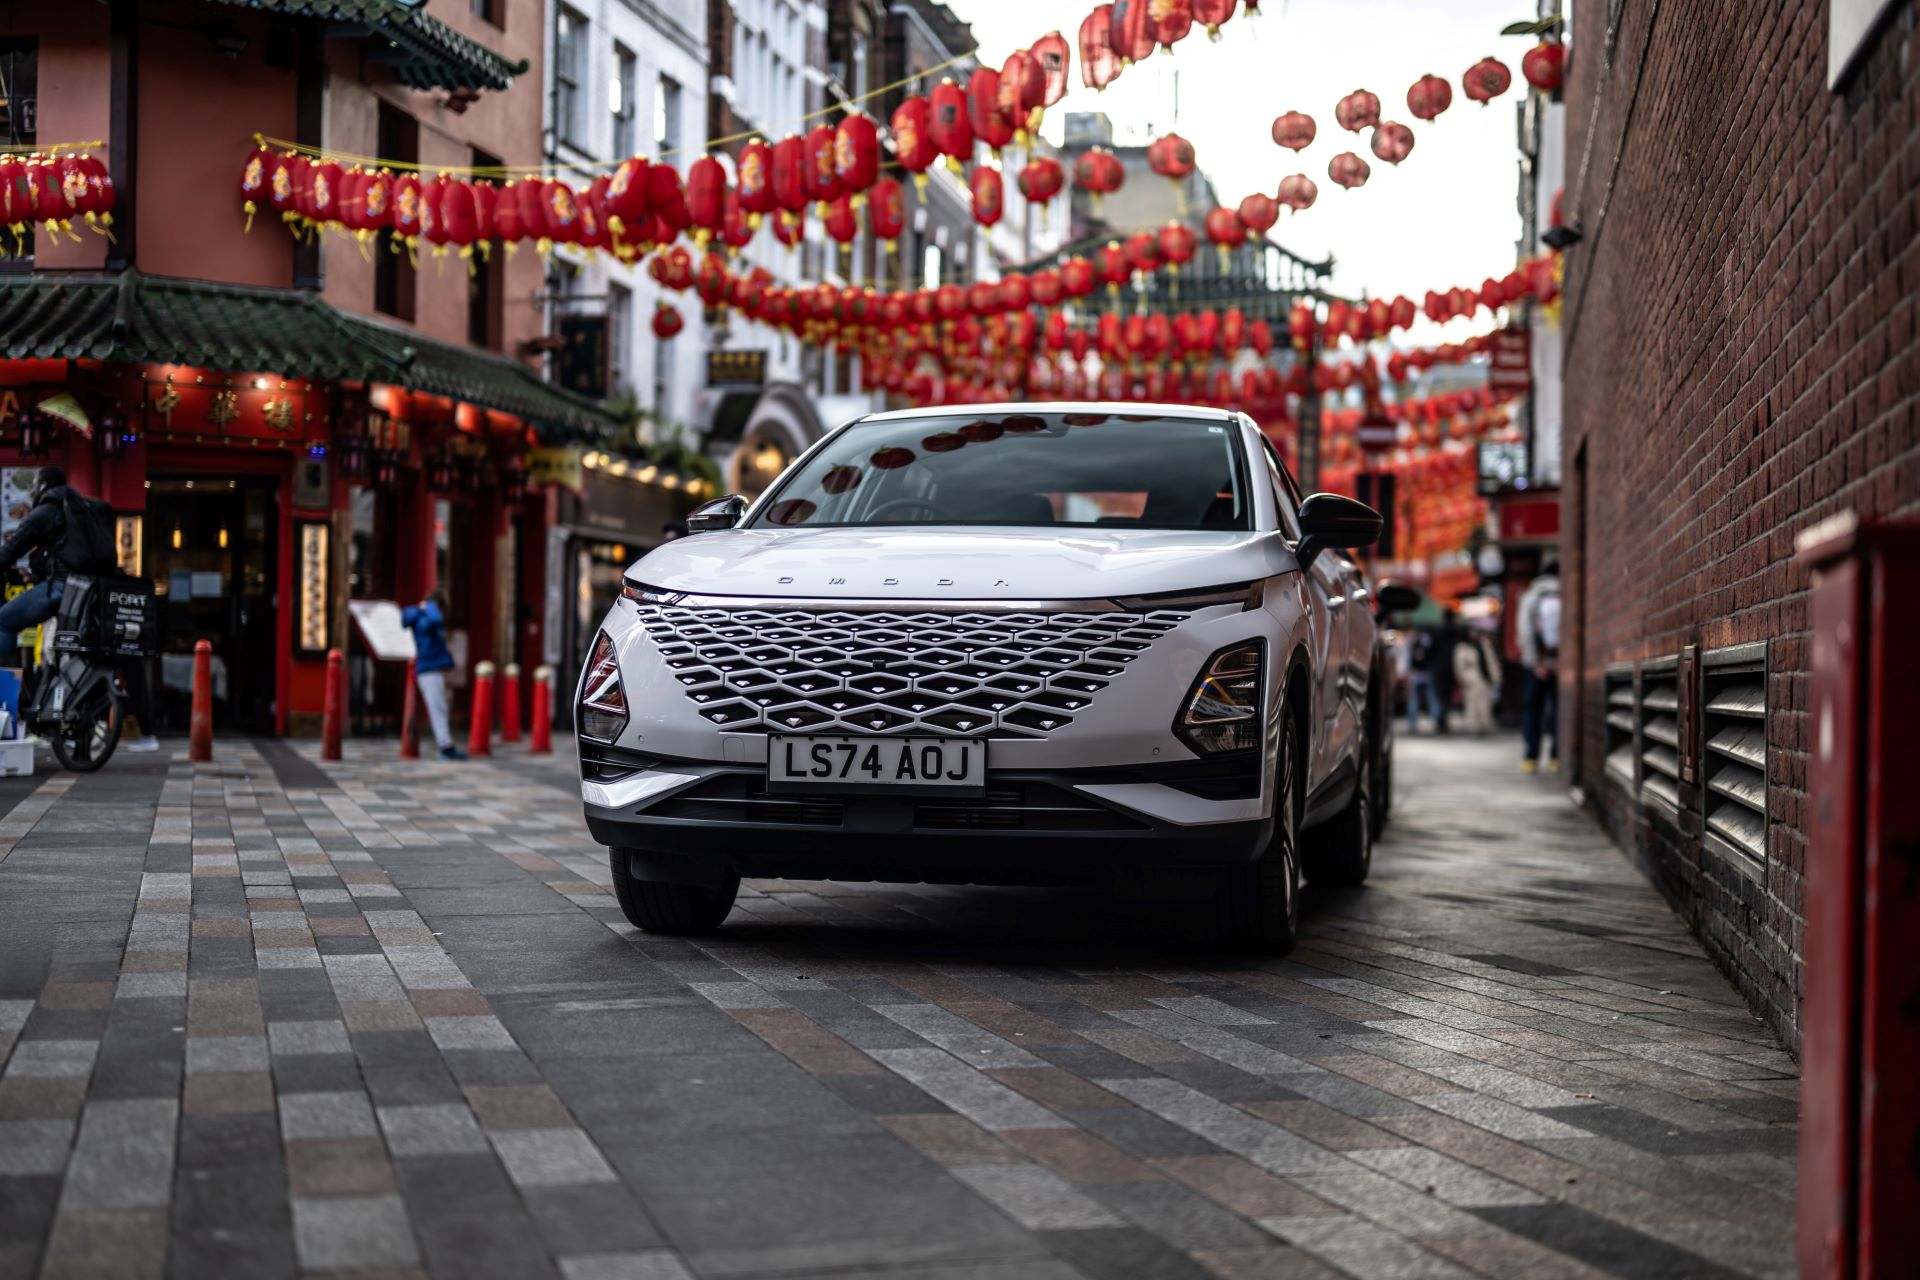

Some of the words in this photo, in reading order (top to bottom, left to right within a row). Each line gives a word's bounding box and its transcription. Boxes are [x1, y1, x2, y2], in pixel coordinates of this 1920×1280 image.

[777, 576, 1009, 587] OMODA
[785, 743, 883, 779] LS74
[895, 745, 969, 781] AOJ
